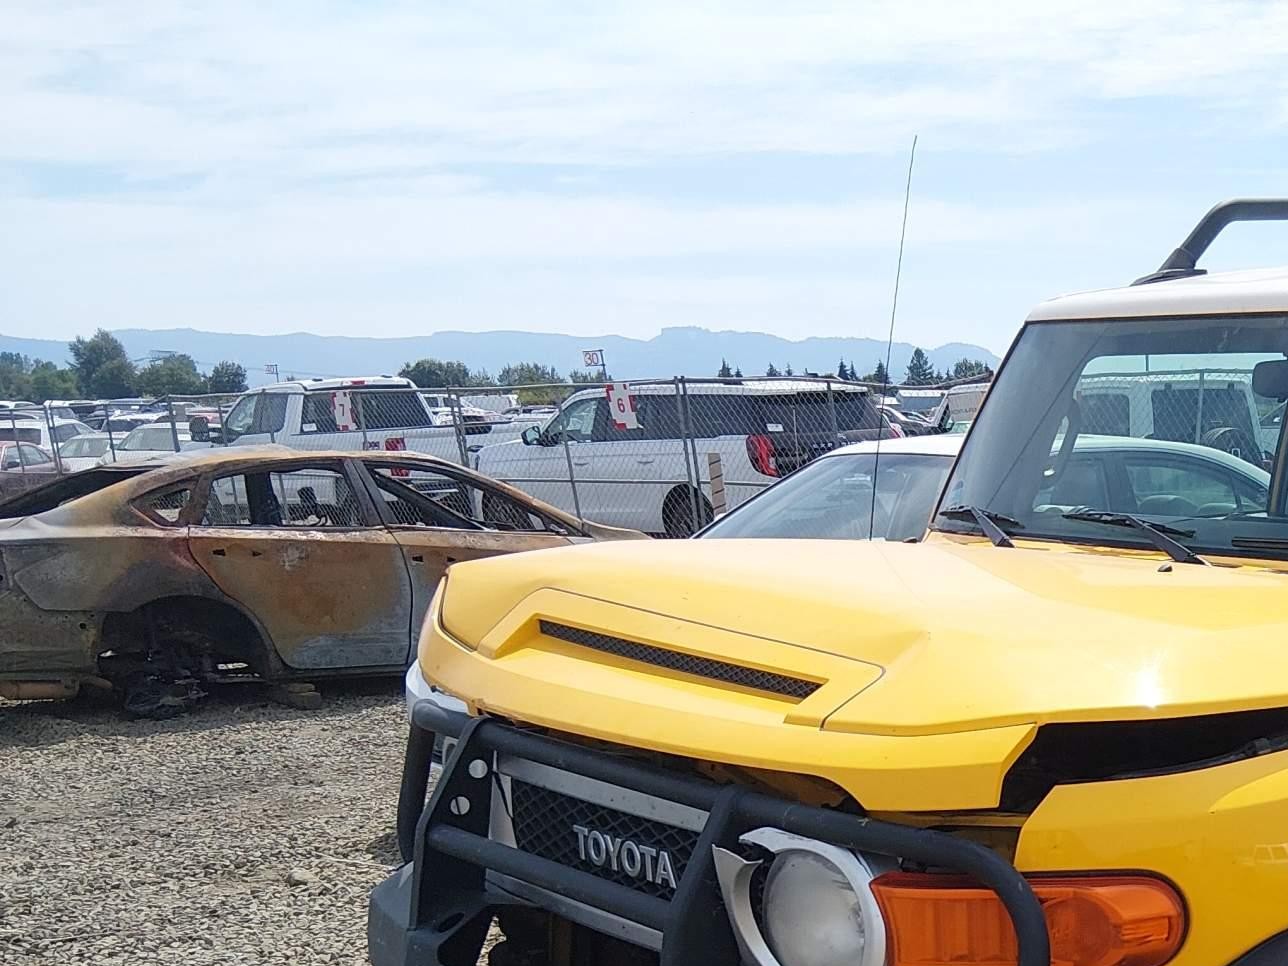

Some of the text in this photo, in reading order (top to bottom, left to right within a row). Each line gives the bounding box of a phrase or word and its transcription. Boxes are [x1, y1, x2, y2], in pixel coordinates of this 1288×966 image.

[584, 352, 600, 365] 30
[338, 403, 345, 417] 7
[616, 398, 626, 413] 6
[573, 824, 677, 889] TOYOTA
